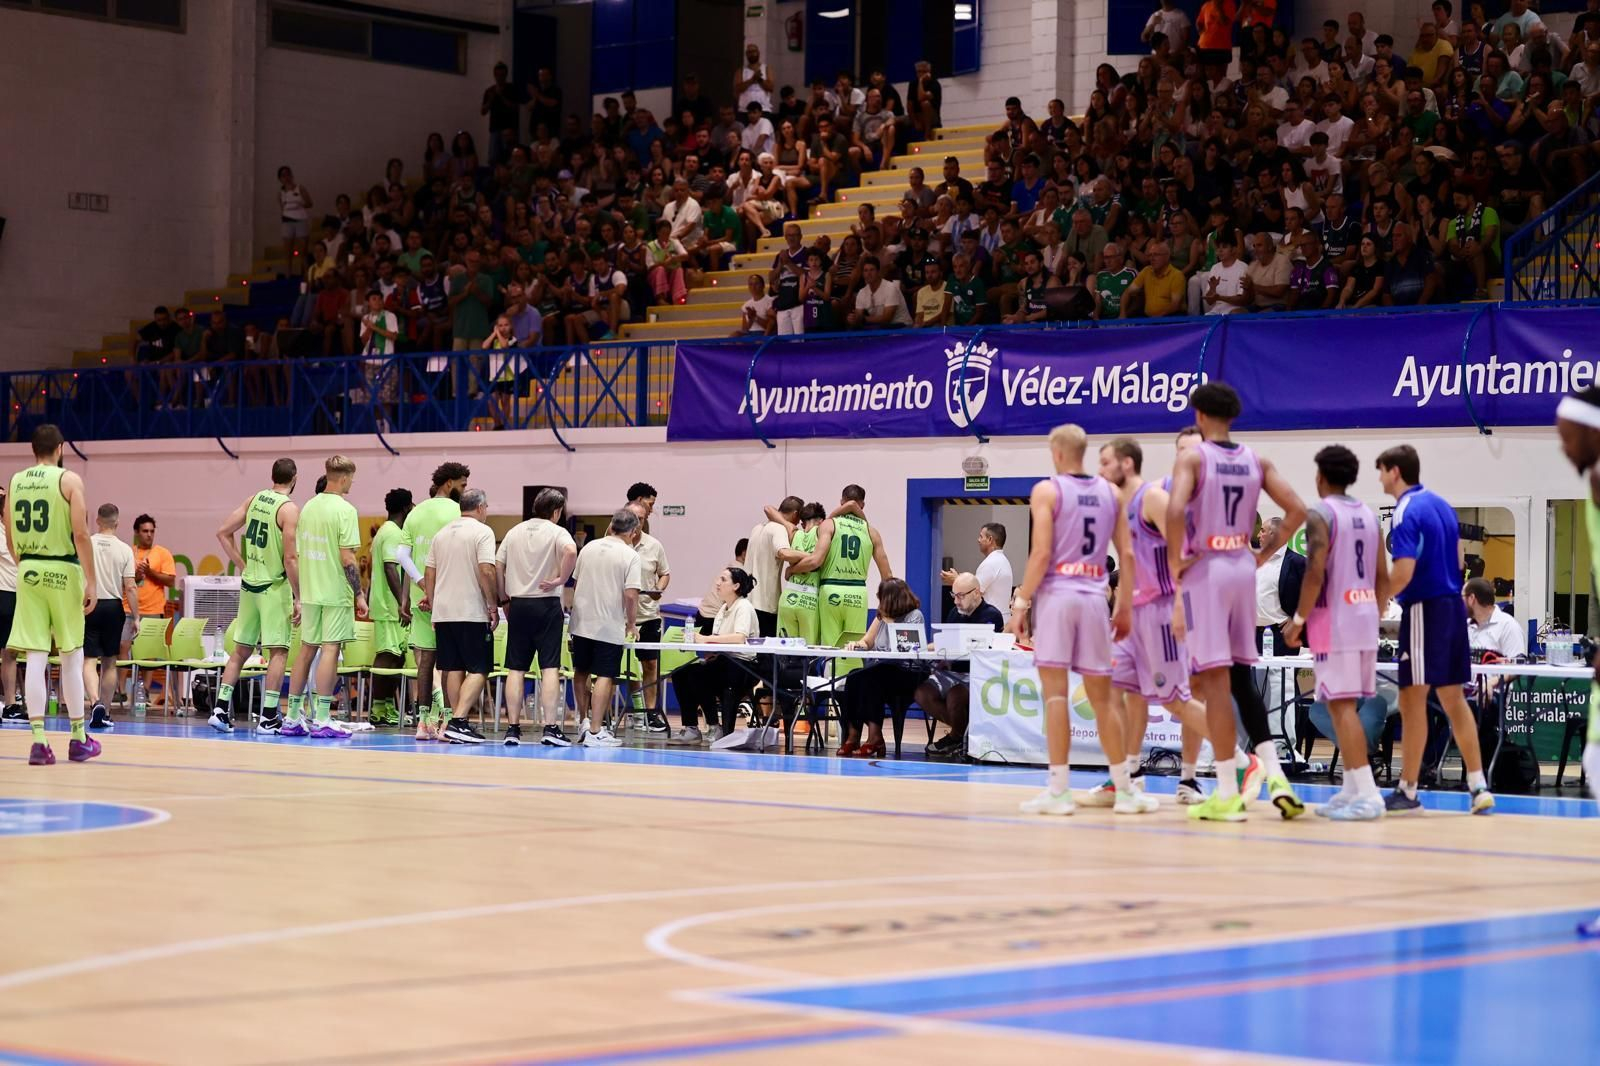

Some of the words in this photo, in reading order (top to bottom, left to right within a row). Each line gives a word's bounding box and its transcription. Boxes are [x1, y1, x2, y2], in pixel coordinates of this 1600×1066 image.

[1392, 348, 1600, 407] Ayuntamie
[738, 372, 933, 423] Ayuntamiento
[15, 499, 49, 533] 33
[1223, 485, 1244, 526] 17
[246, 518, 268, 549] 45
[841, 534, 861, 560] 19
[1082, 517, 1096, 556] 5
[44, 571, 68, 582] COSTA
[1355, 539, 1364, 579] 8
[1145, 731, 1167, 744] stra
